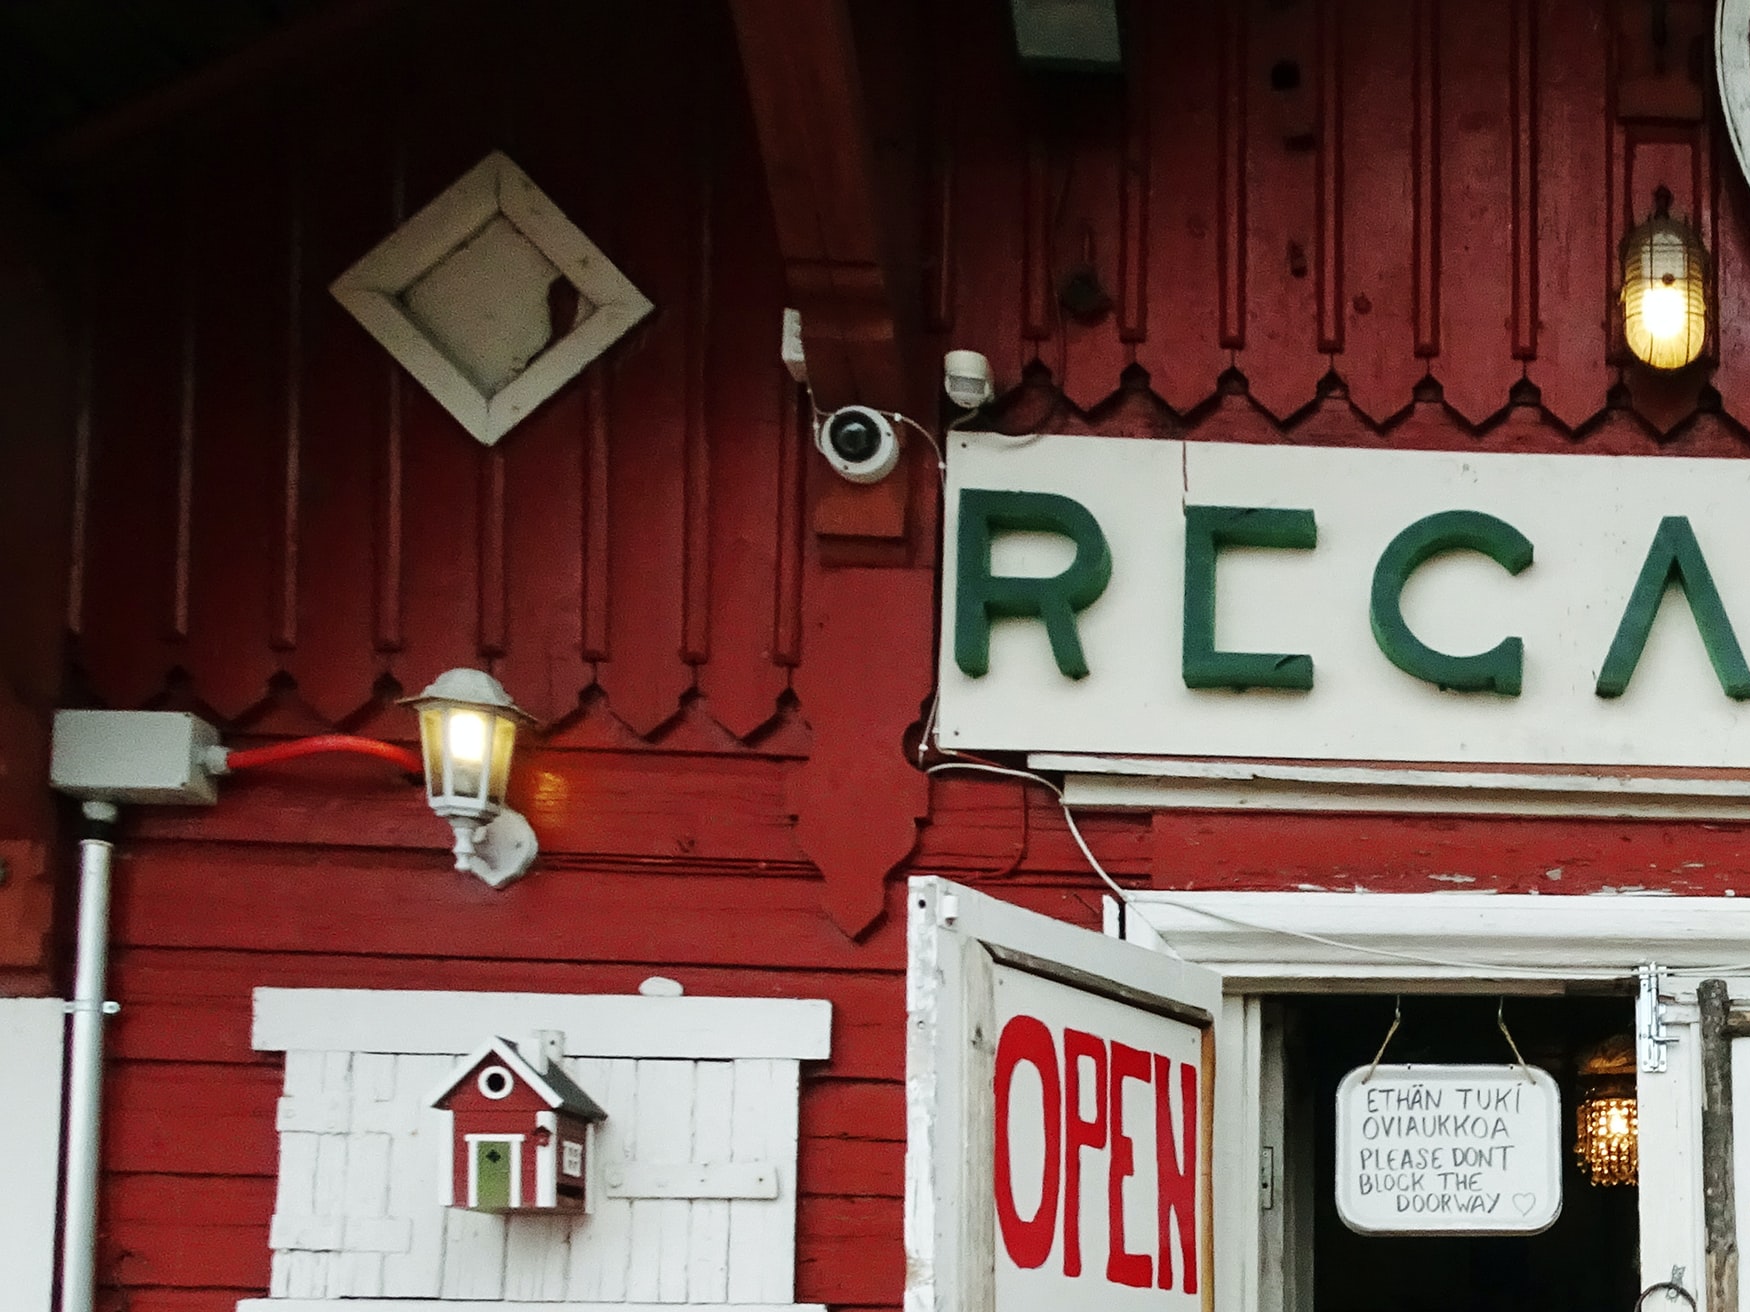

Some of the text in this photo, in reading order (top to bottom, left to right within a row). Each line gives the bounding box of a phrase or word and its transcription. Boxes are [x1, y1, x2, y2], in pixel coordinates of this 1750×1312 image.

[1367, 1083, 1523, 1114] ETHÄN TUKI
[1362, 1114, 1510, 1140] OVIAUKKOA
[994, 1015, 1197, 1295] OPEN
[1360, 1145, 1515, 1172] PLEASE DONT
[1359, 1172, 1483, 1196] BLOCK THE
[1396, 1193, 1501, 1214] DOORWAY
